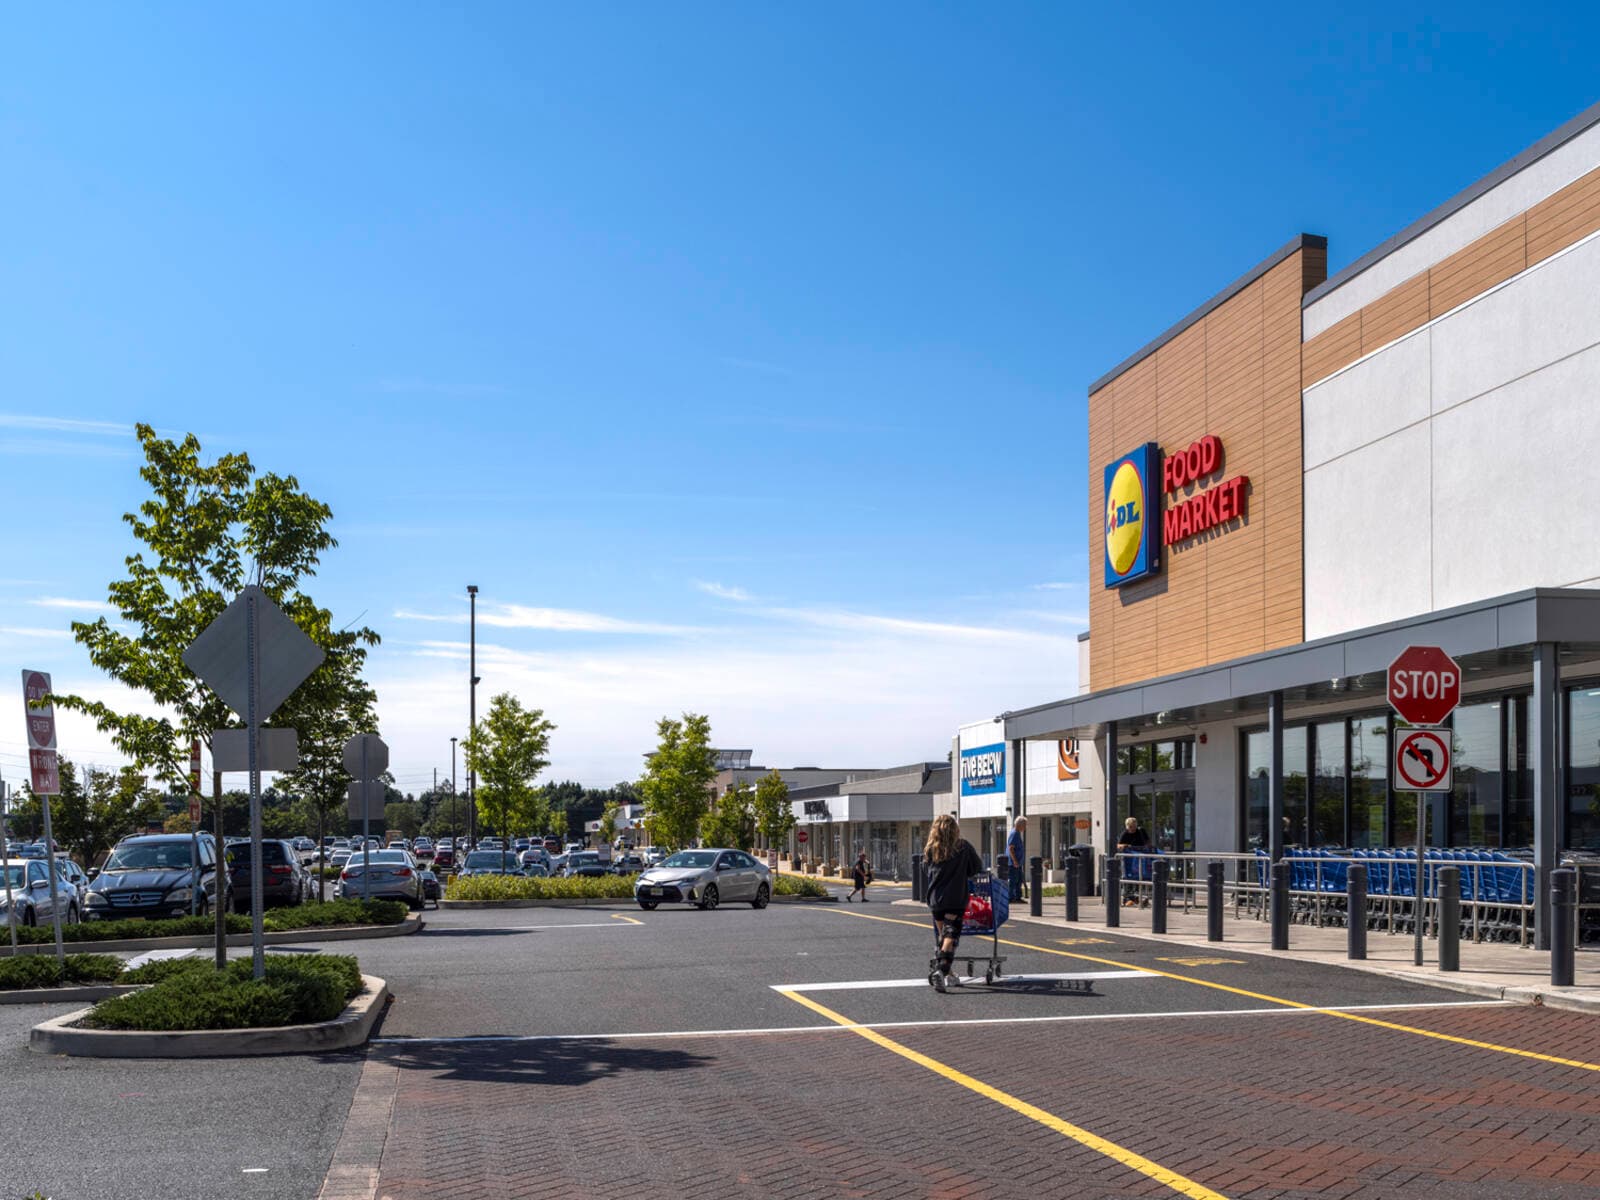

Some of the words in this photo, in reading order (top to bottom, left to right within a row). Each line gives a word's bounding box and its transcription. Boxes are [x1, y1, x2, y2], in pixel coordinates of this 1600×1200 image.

[1164, 435, 1220, 493] FOOD
[1164, 476, 1247, 545] MARKET
[1393, 670, 1456, 700] STOP
[32, 720, 49, 733] ENTER
[32, 755, 57, 769] WRONG
[39, 774, 53, 787] WAY
